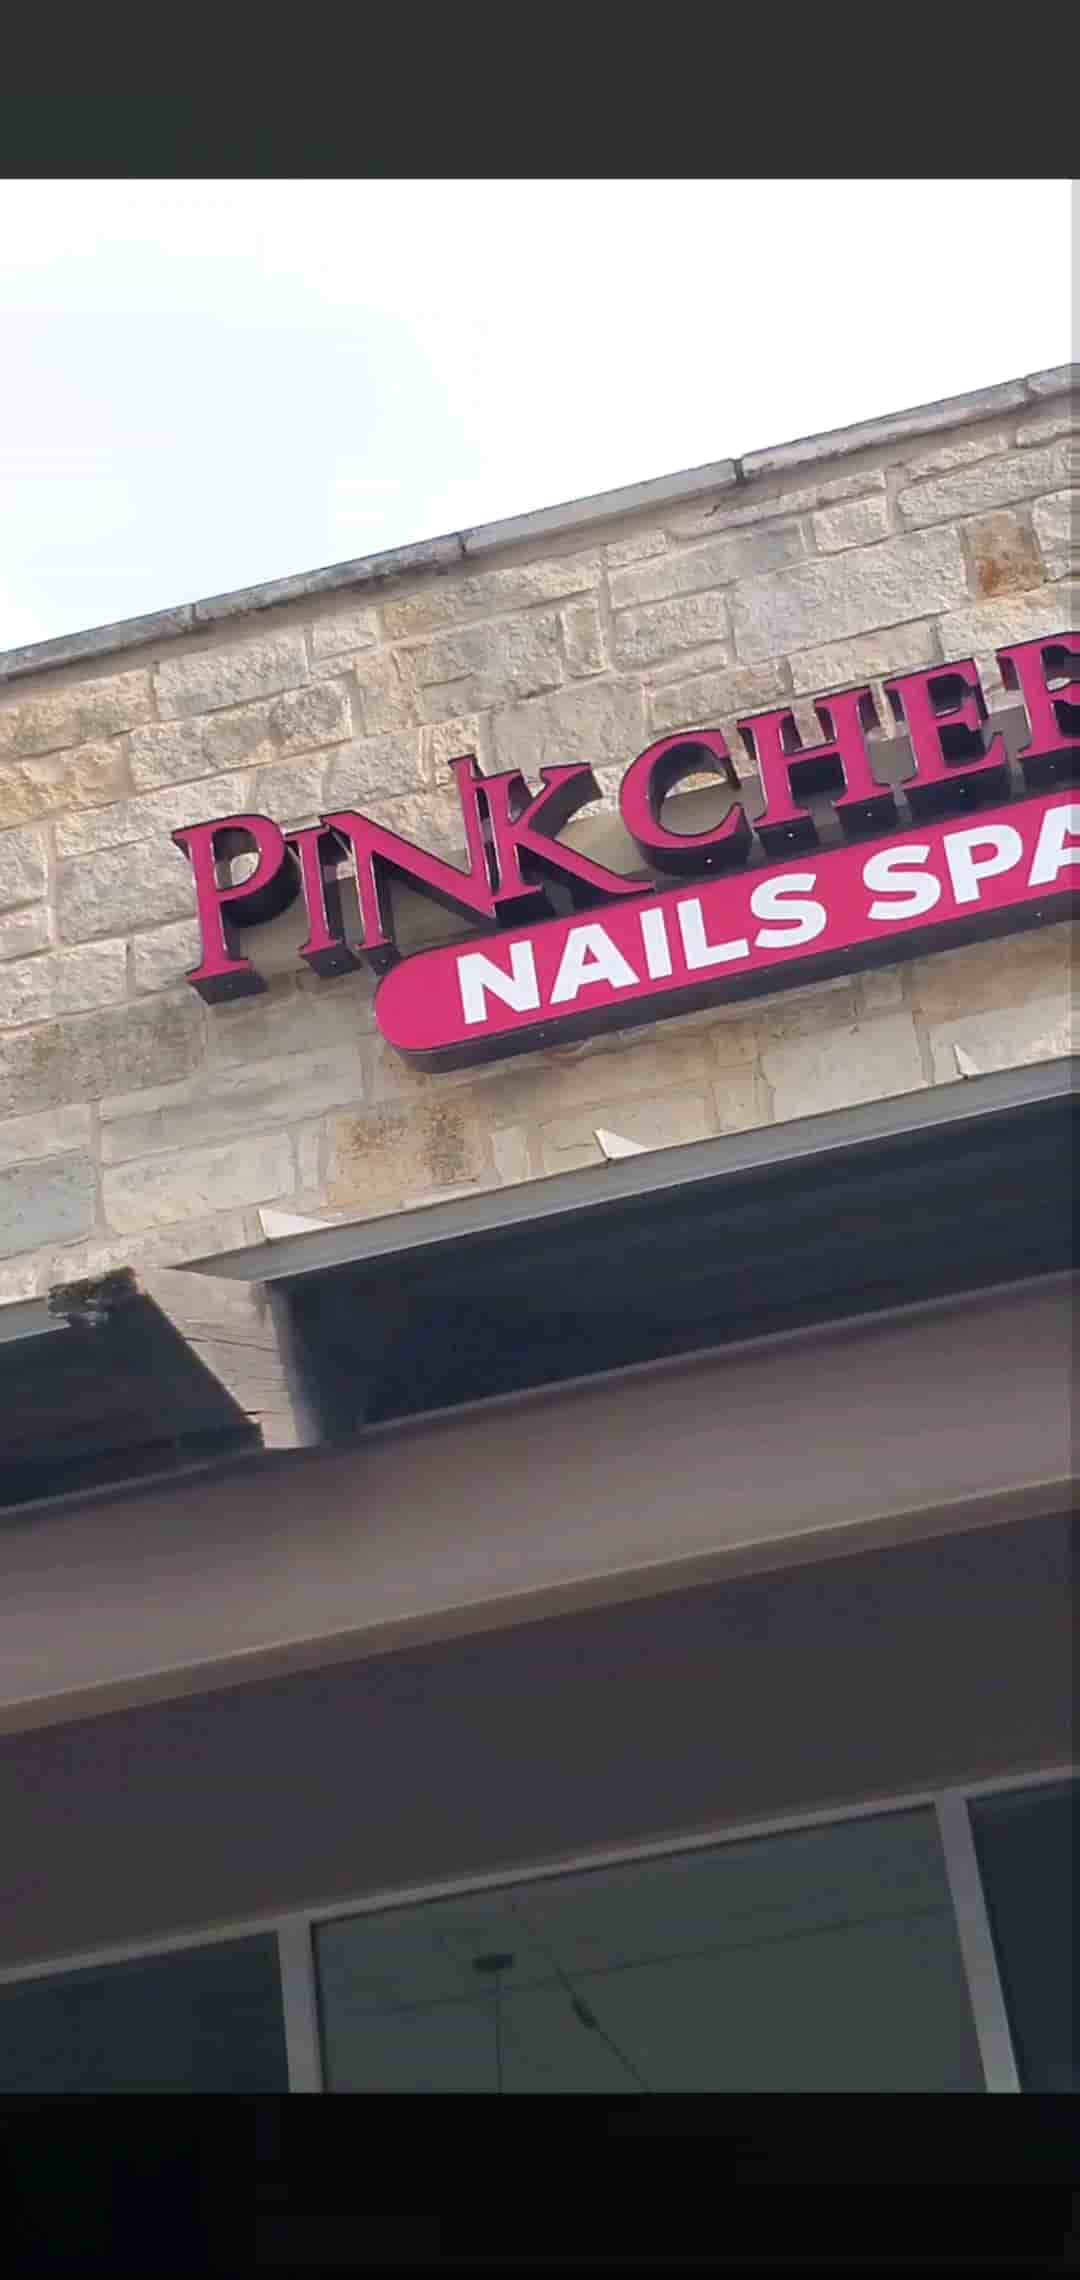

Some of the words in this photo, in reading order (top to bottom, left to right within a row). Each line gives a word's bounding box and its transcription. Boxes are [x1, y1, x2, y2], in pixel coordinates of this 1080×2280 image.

[171, 754, 656, 984] PINK
[456, 872, 827, 1026] NAILS
[862, 803, 1080, 921] SPA
